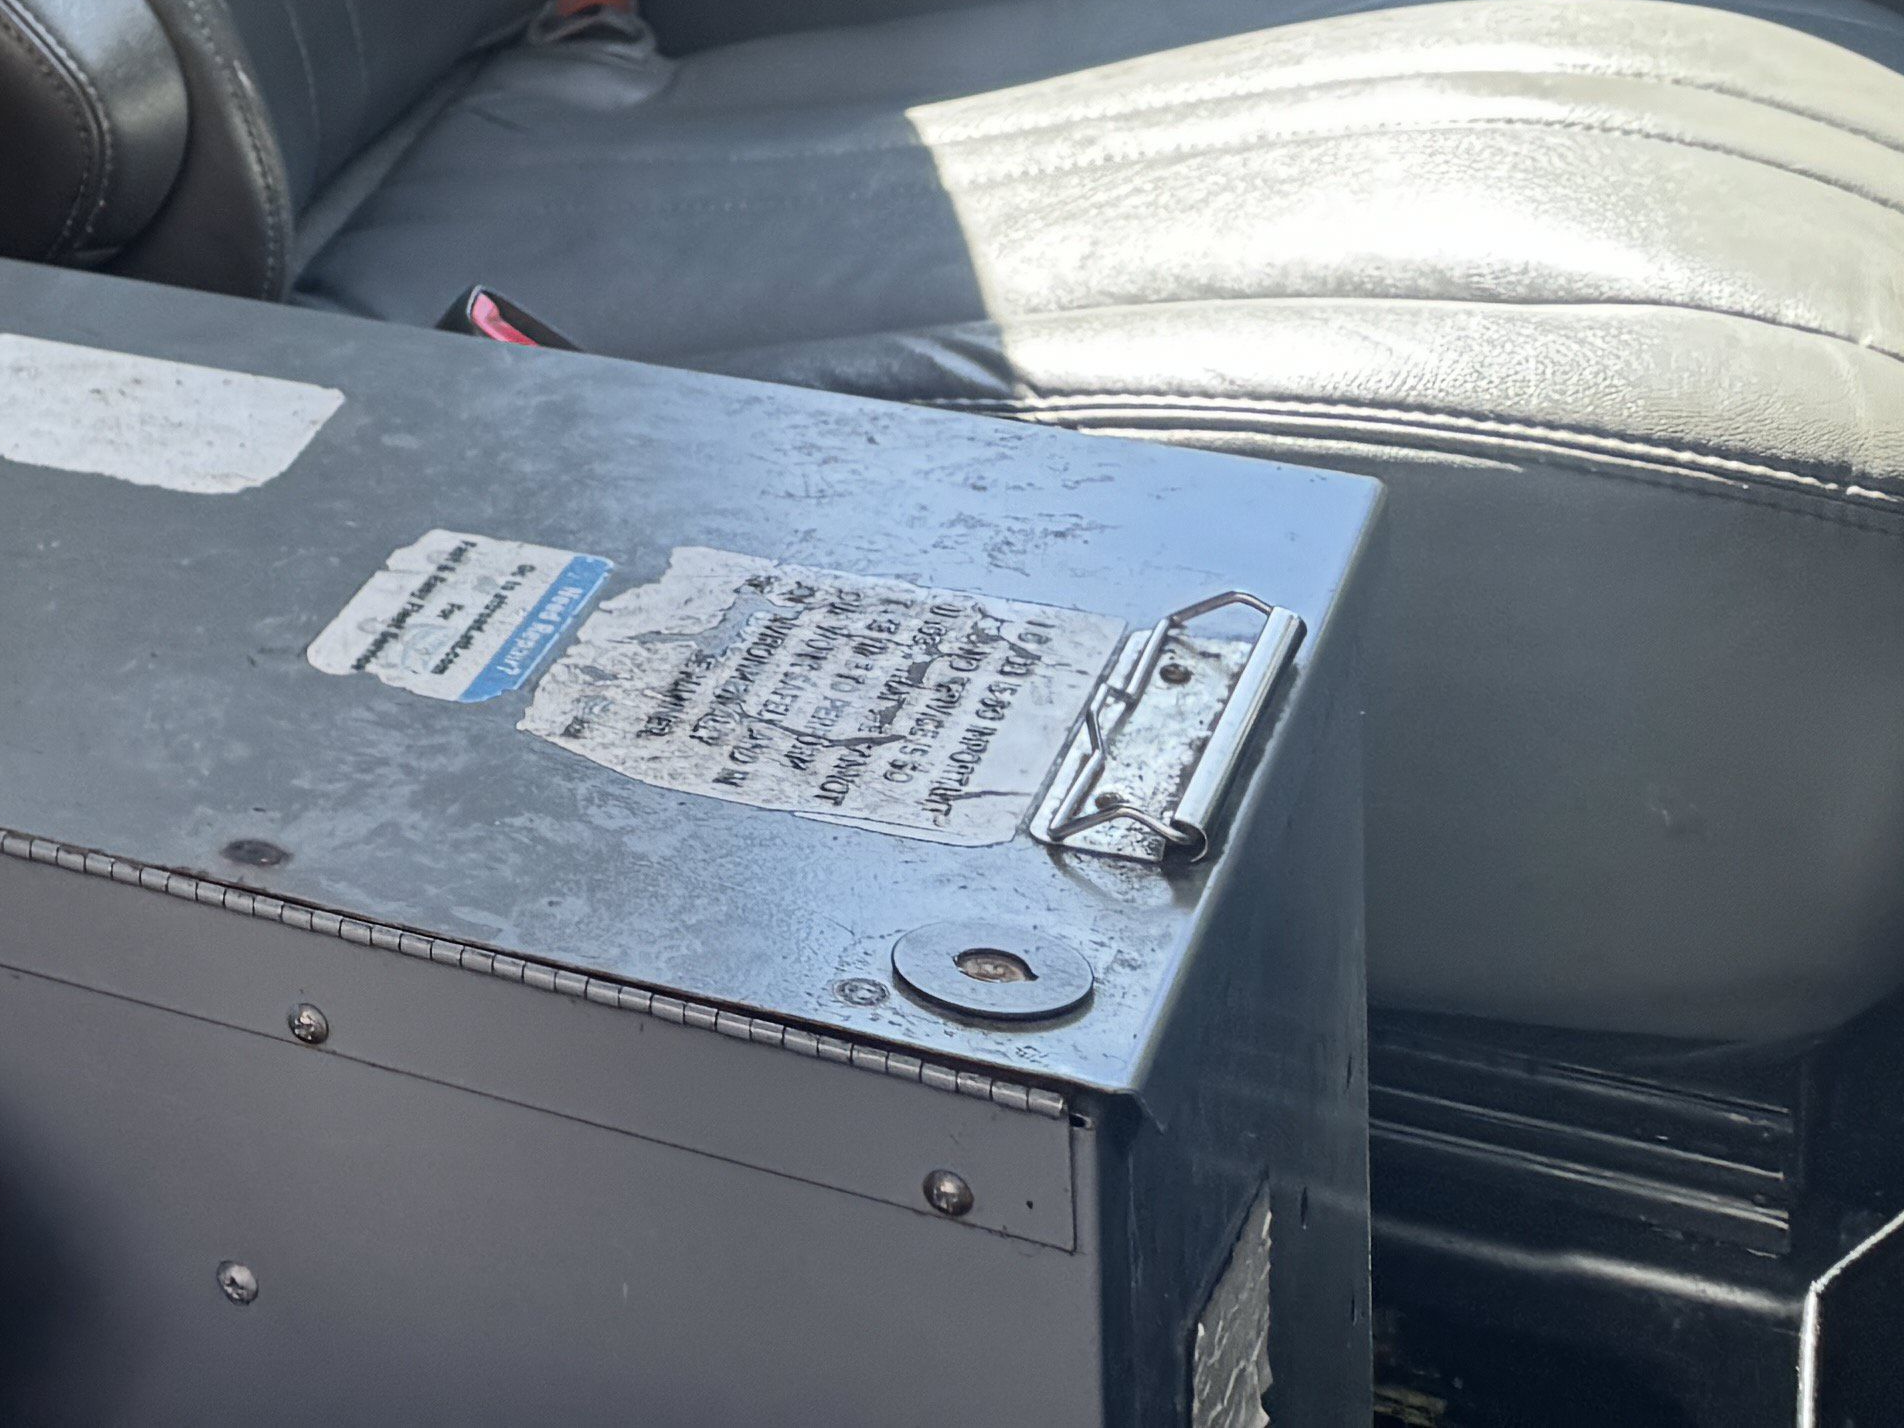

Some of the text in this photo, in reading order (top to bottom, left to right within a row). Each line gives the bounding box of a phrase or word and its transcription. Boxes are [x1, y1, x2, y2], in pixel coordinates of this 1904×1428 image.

[435, 601, 467, 622] For
[496, 585, 586, 675] Need Repair?
